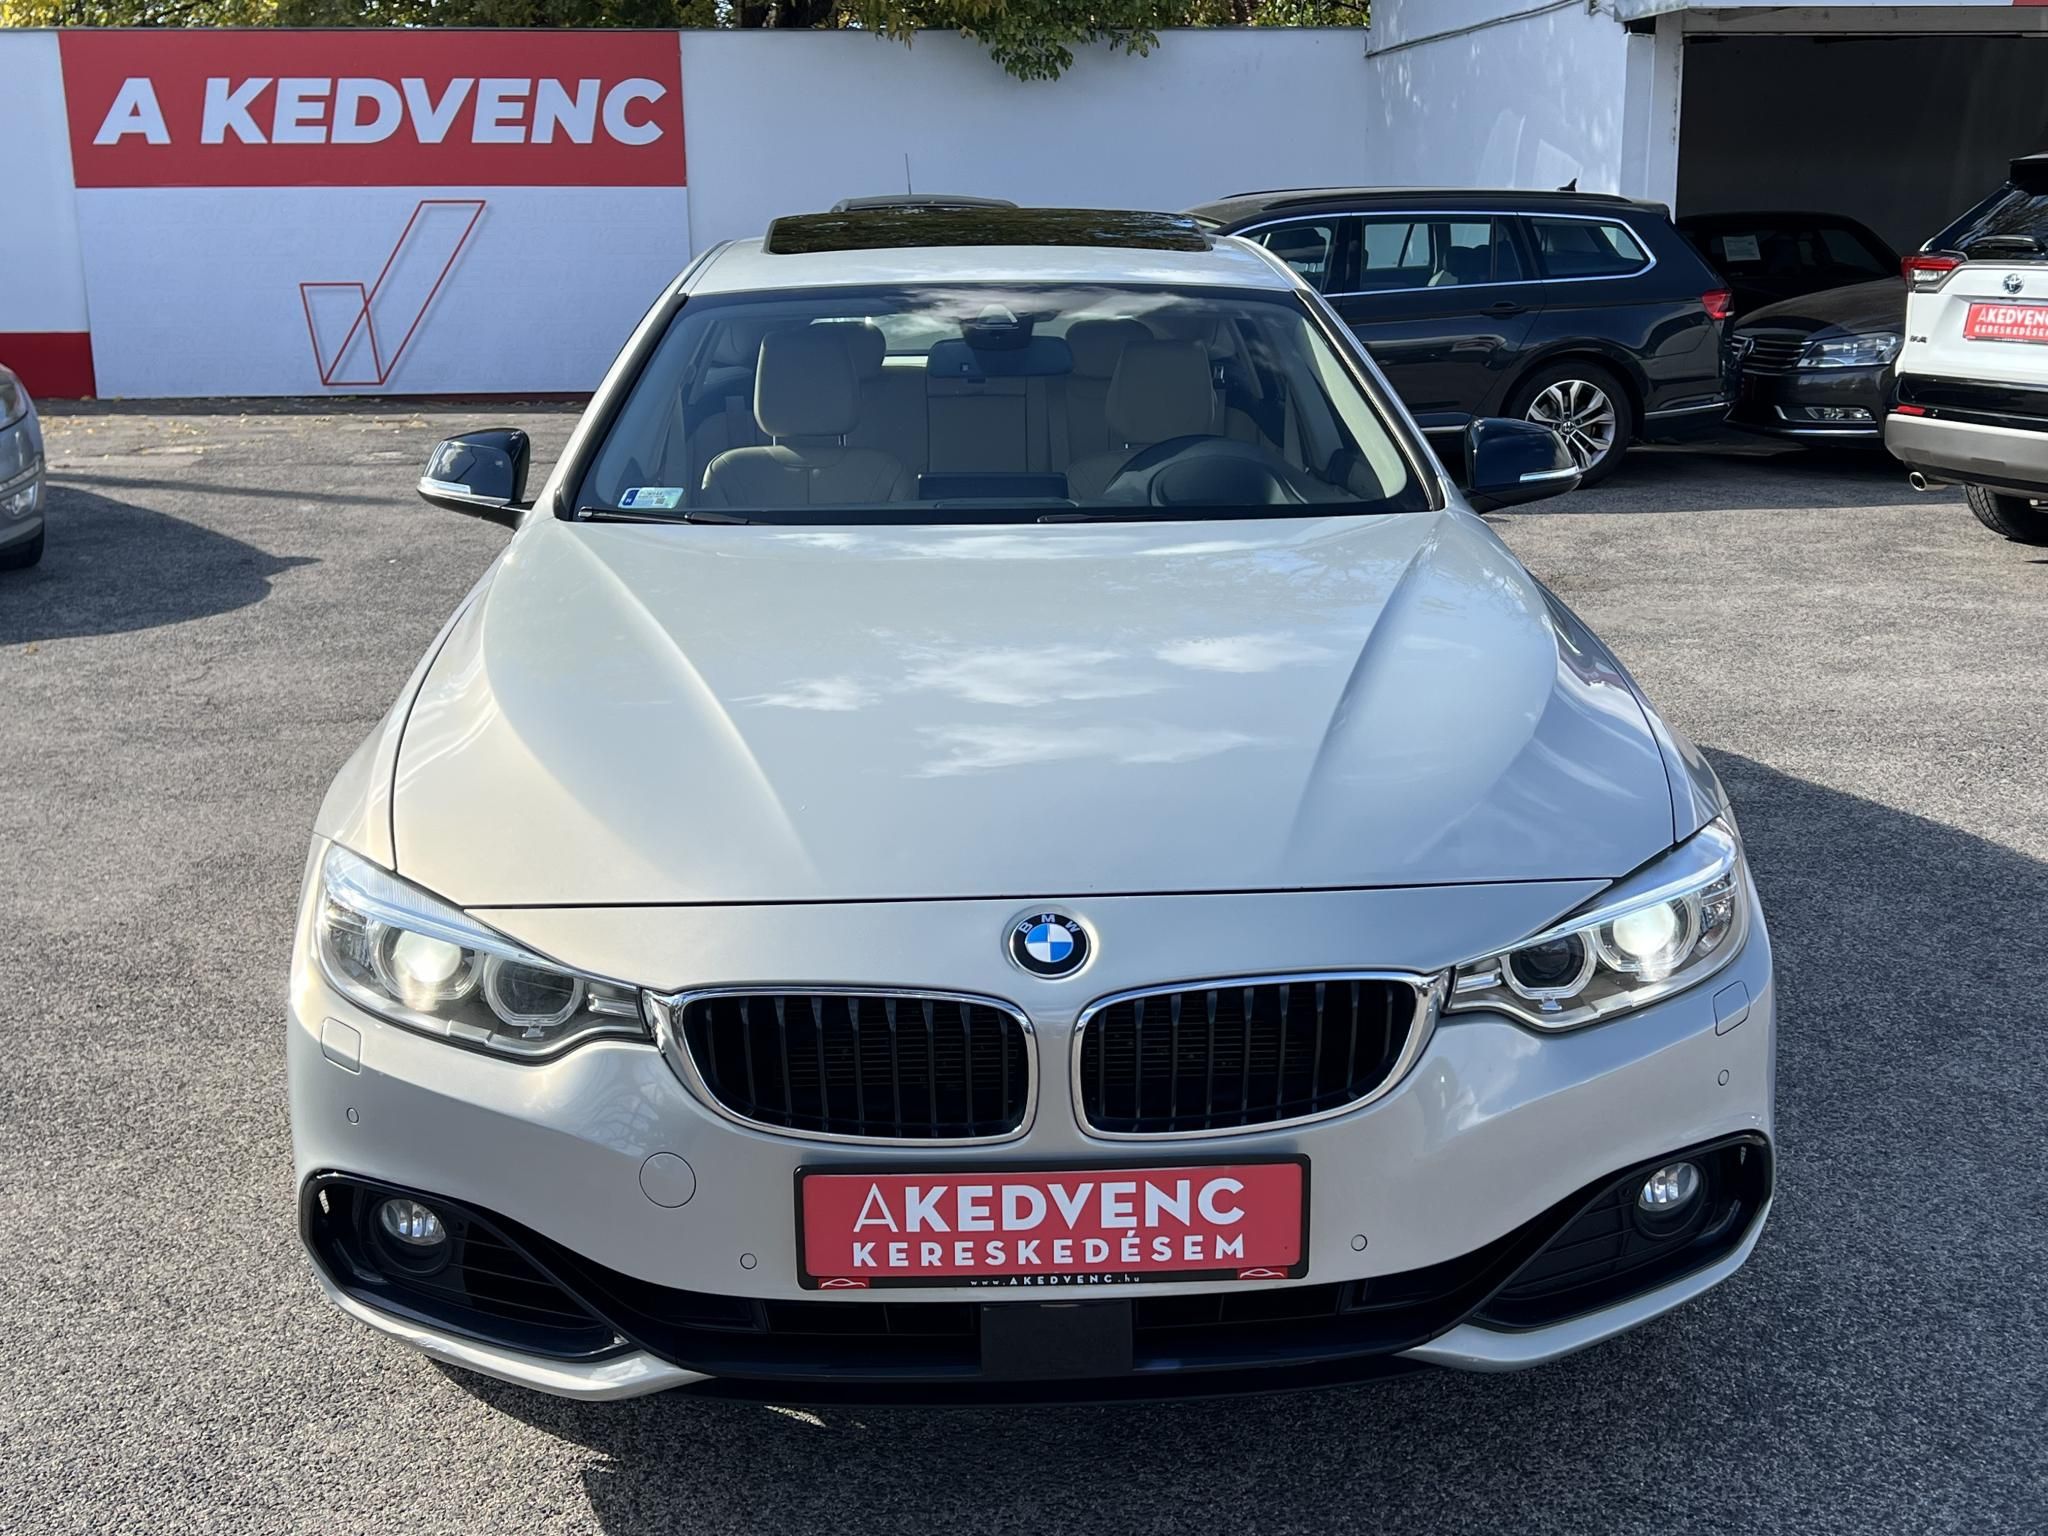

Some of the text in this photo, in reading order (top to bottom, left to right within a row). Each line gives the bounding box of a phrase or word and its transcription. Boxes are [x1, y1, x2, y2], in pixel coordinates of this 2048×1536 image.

[93, 77, 667, 145] A KEDVENC
[1018, 914, 1081, 933] BMW
[853, 1178, 1245, 1233] AKEDVENC
[852, 1230, 1245, 1267] KERESKEDÉSEM
[970, 1274, 1140, 1286] www.AKEDVENC.hu
